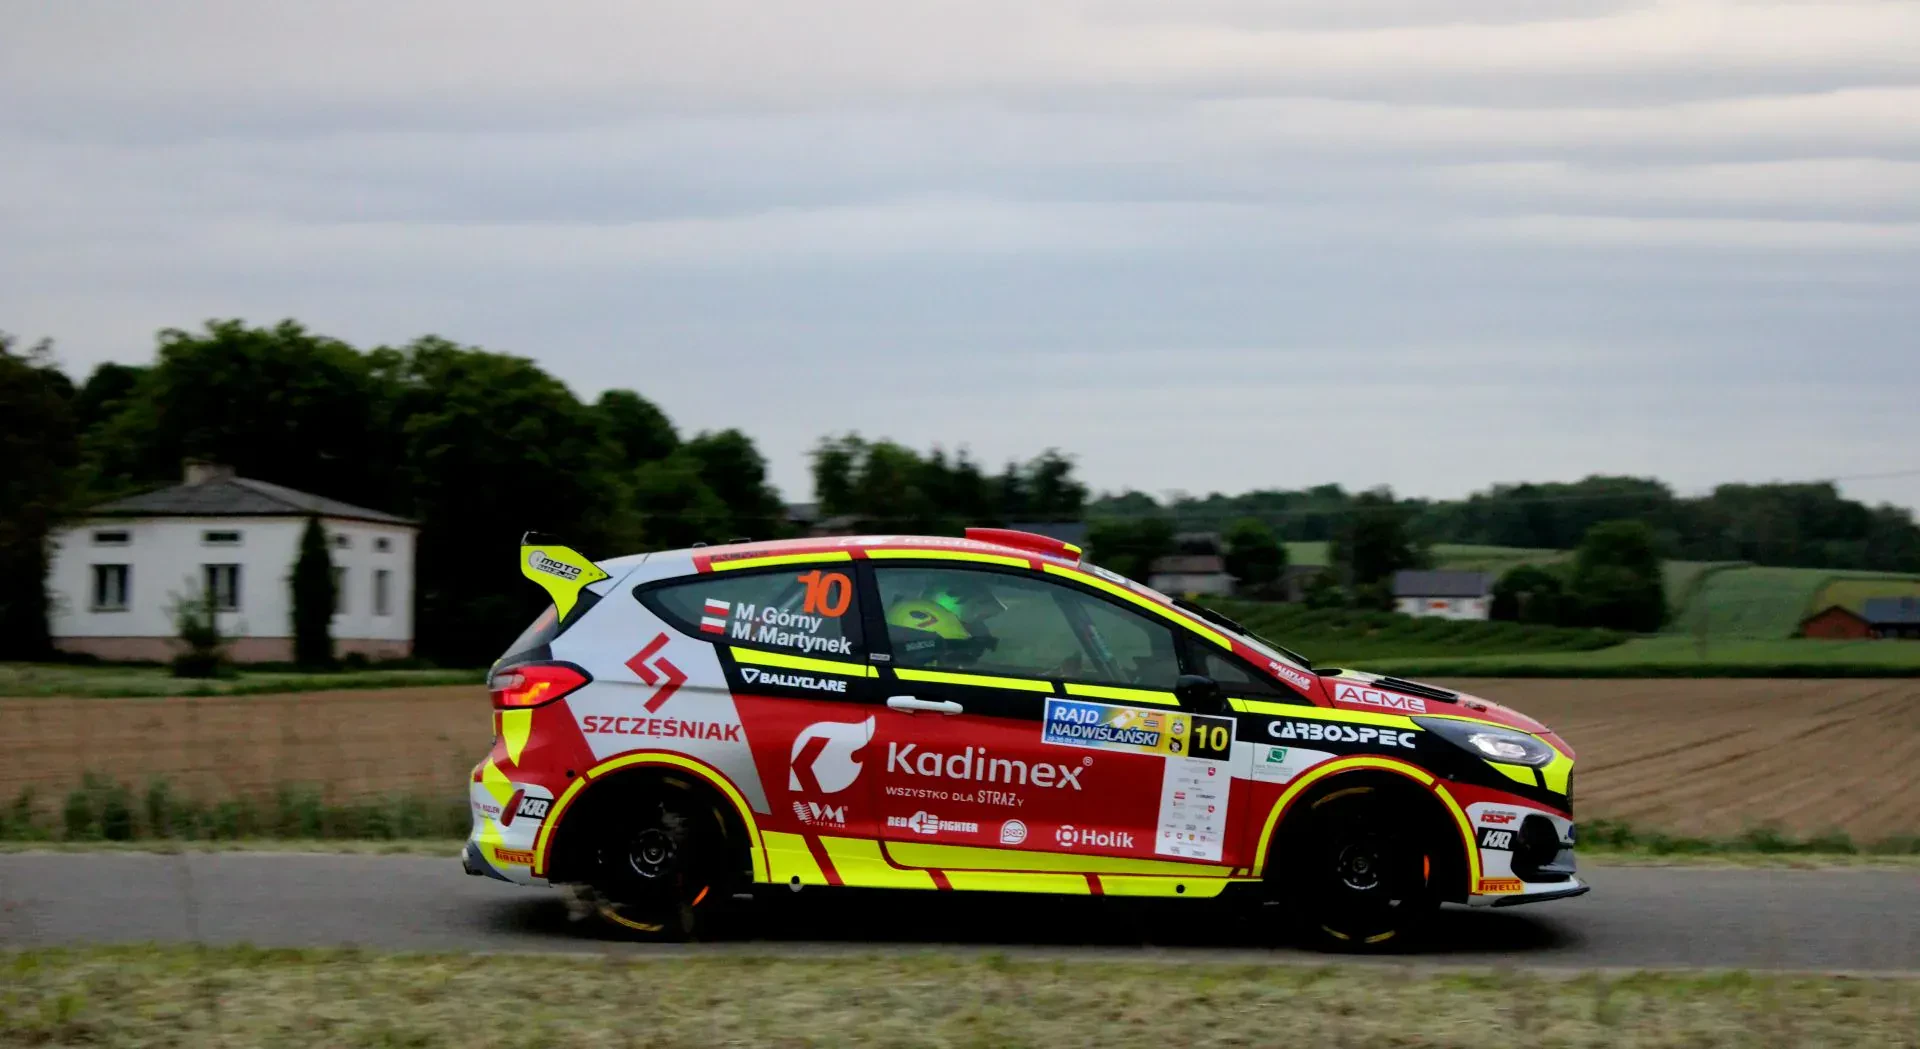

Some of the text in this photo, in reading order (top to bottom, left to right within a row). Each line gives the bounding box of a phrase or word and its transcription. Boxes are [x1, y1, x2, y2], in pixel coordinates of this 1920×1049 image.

[541, 557, 582, 575] MOTO
[797, 569, 852, 617] 10
[760, 672, 847, 692] BALLYCLARE
[1339, 687, 1425, 711] ACME
[1054, 706, 1099, 725] RAJD
[583, 715, 741, 743] SZCZĘŚNIAK
[1050, 721, 1160, 746] NADWIŚLAŃSKI
[1195, 724, 1228, 751] 10
[1267, 720, 1416, 749] CARBOSPEC
[885, 785, 948, 801] WSZYSTKO
[952, 791, 974, 803] DLA
[887, 815, 979, 834] RED FIGHTER
[1081, 828, 1134, 849] Holík
[494, 847, 536, 864] PIRELLI
[1478, 879, 1522, 892] PIRELLI
